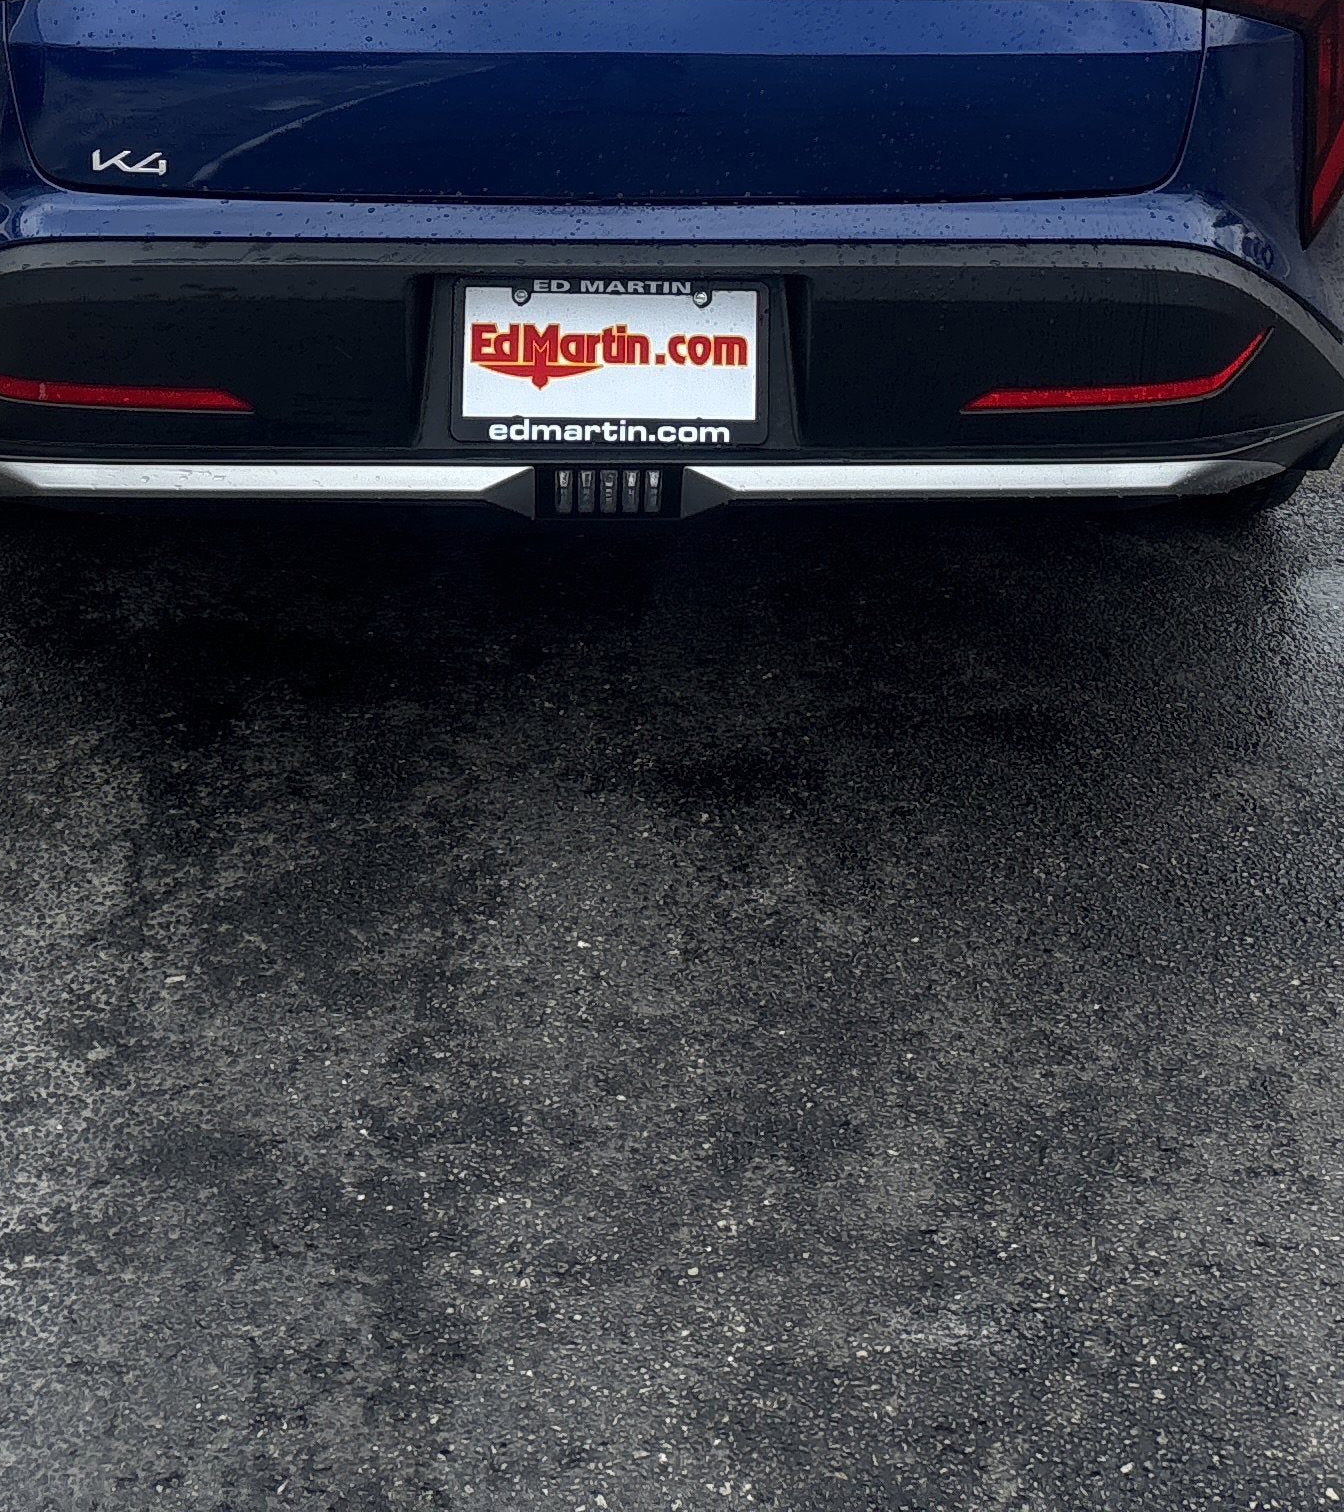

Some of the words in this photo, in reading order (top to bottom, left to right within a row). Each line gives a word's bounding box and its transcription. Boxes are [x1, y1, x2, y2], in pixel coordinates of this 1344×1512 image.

[92, 149, 167, 176] K4
[533, 279, 570, 292] ED
[580, 280, 692, 294] MARTIN
[488, 418, 730, 443] edmartin.com
